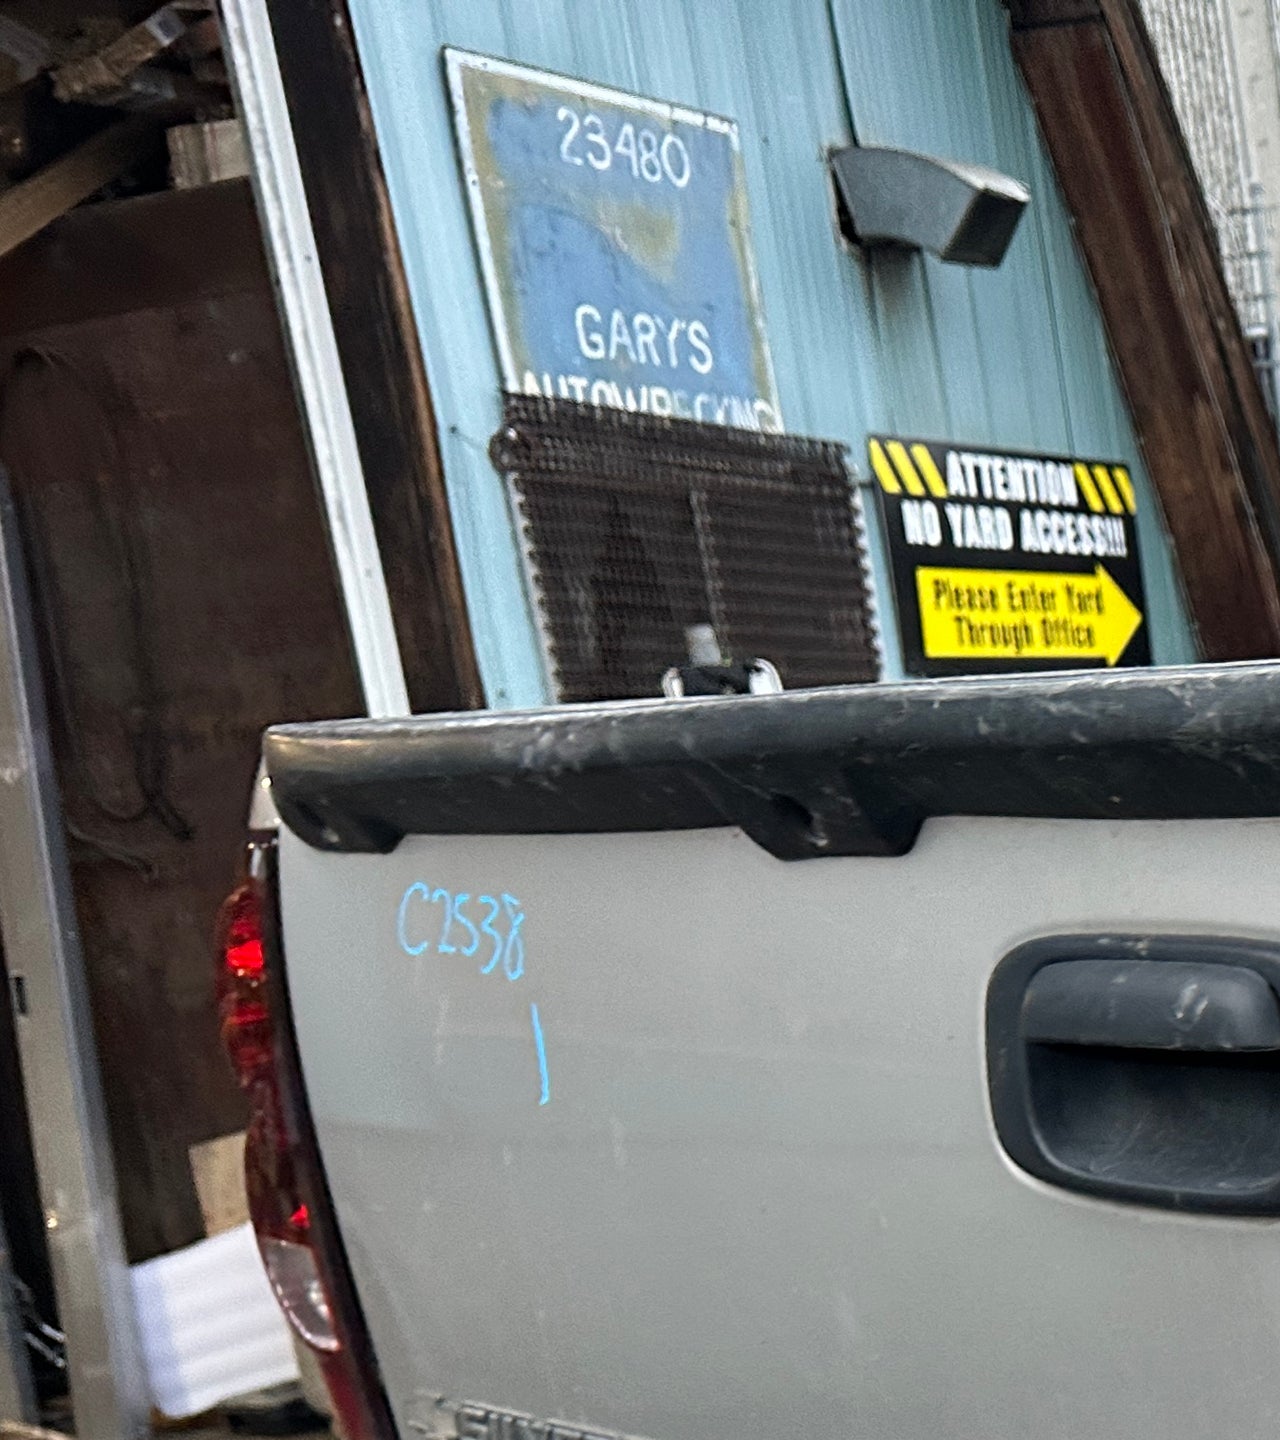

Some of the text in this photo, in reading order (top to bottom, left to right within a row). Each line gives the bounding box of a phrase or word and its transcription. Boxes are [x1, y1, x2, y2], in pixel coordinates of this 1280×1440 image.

[556, 106, 691, 187] 23480
[575, 304, 713, 375] GARY'S
[946, 450, 1079, 506] ATTENTION
[901, 499, 943, 547] NO
[944, 503, 1014, 550] YARD
[932, 578, 1105, 615] Please Enter Yard
[955, 615, 1096, 655] Through Office
[397, 880, 526, 982] C2538
